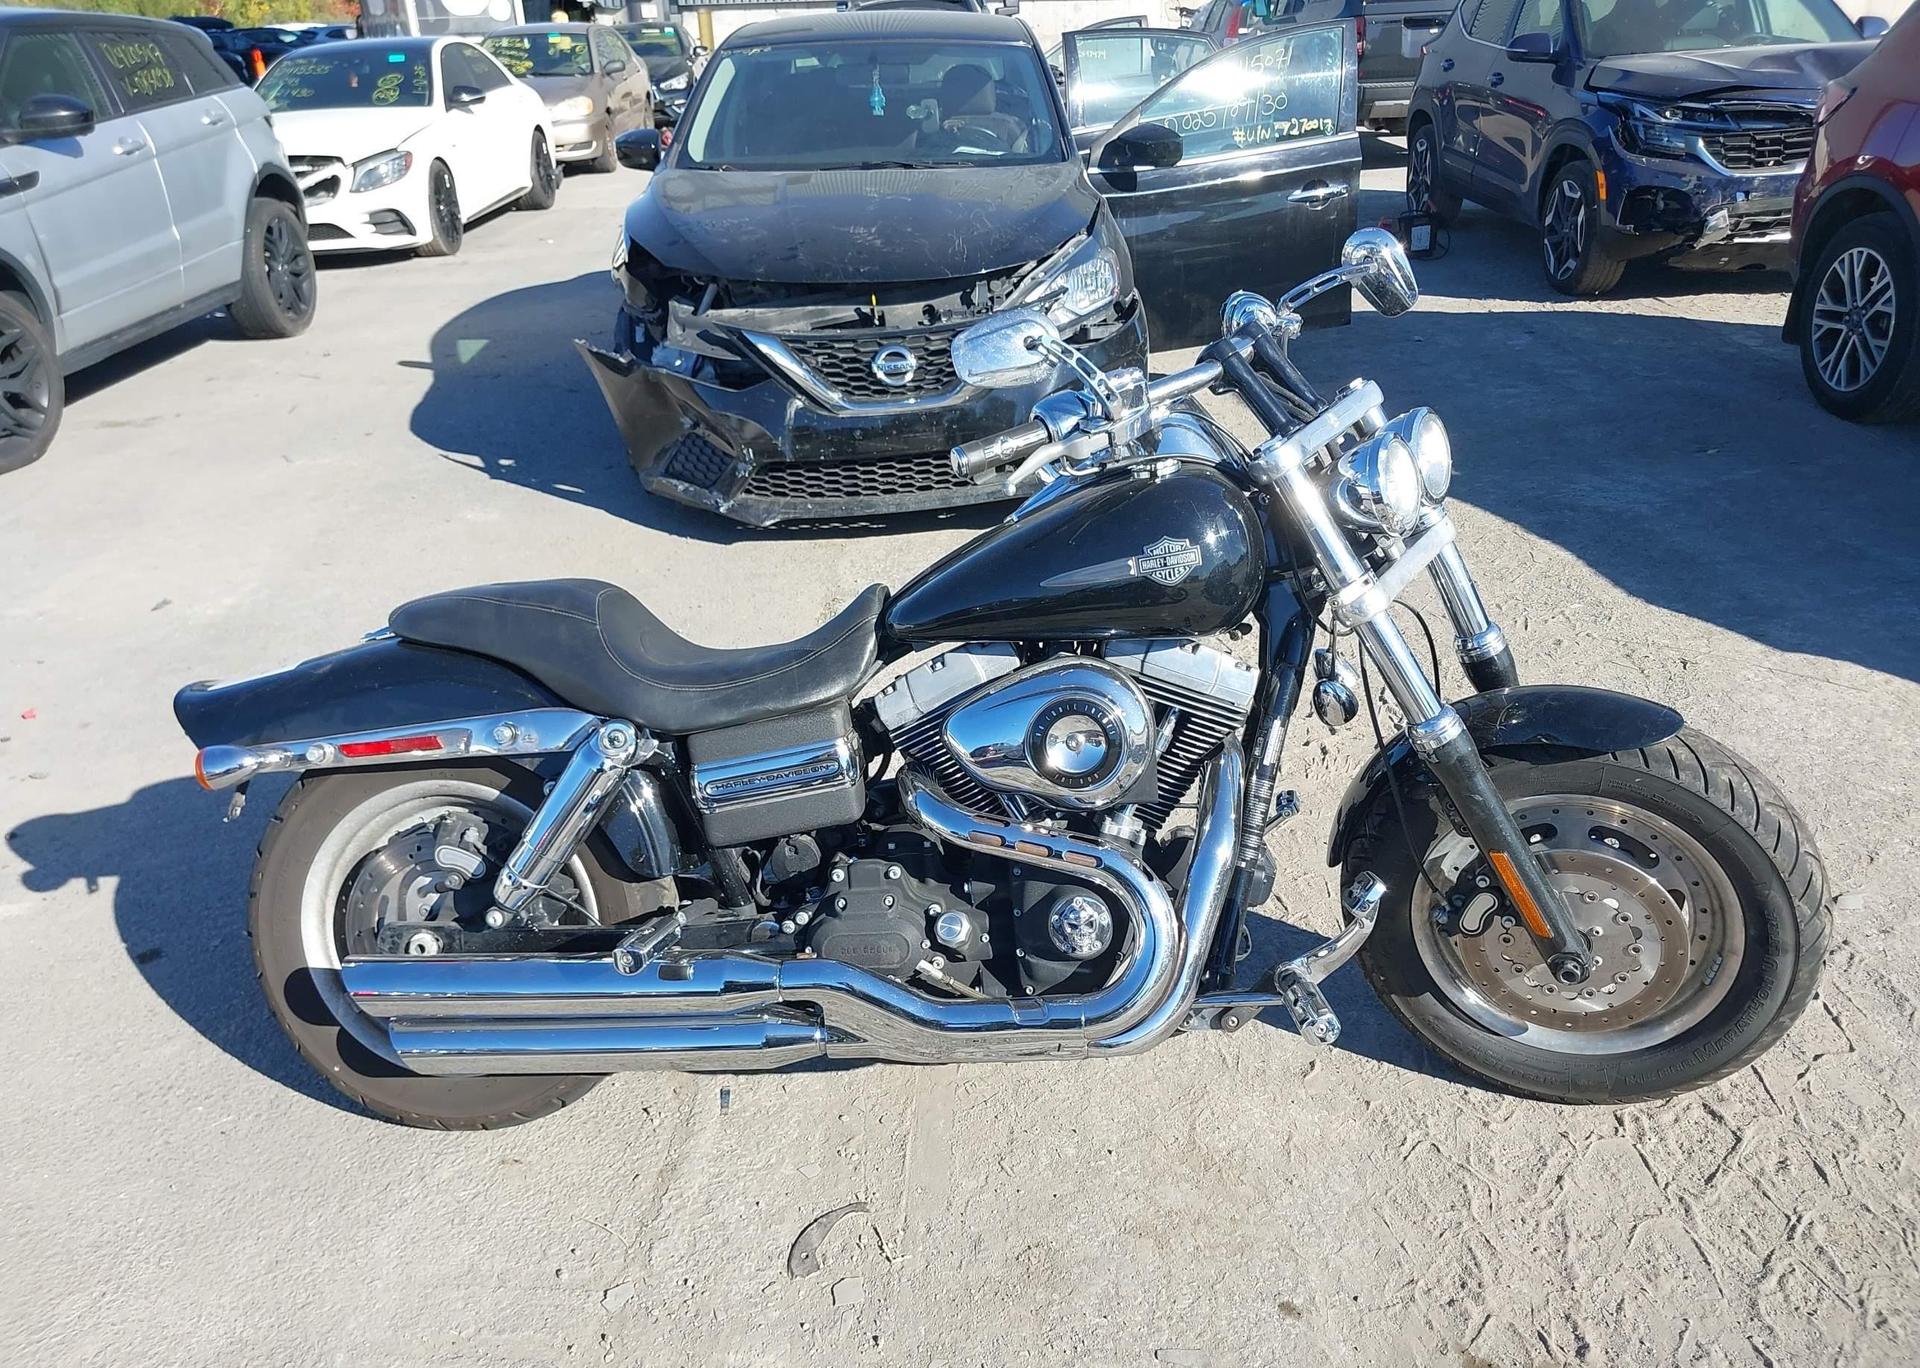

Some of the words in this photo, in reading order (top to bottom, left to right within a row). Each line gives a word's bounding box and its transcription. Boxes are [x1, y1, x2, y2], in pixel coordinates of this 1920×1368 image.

[877, 362, 913, 371] NISSAN
[1153, 542, 1183, 556] MOTOR
[1142, 552, 1196, 570] HARLEY-DAVIDSON
[1156, 566, 1185, 580] CYCLES
[713, 764, 831, 791] HARLEY-DAVIDSON
